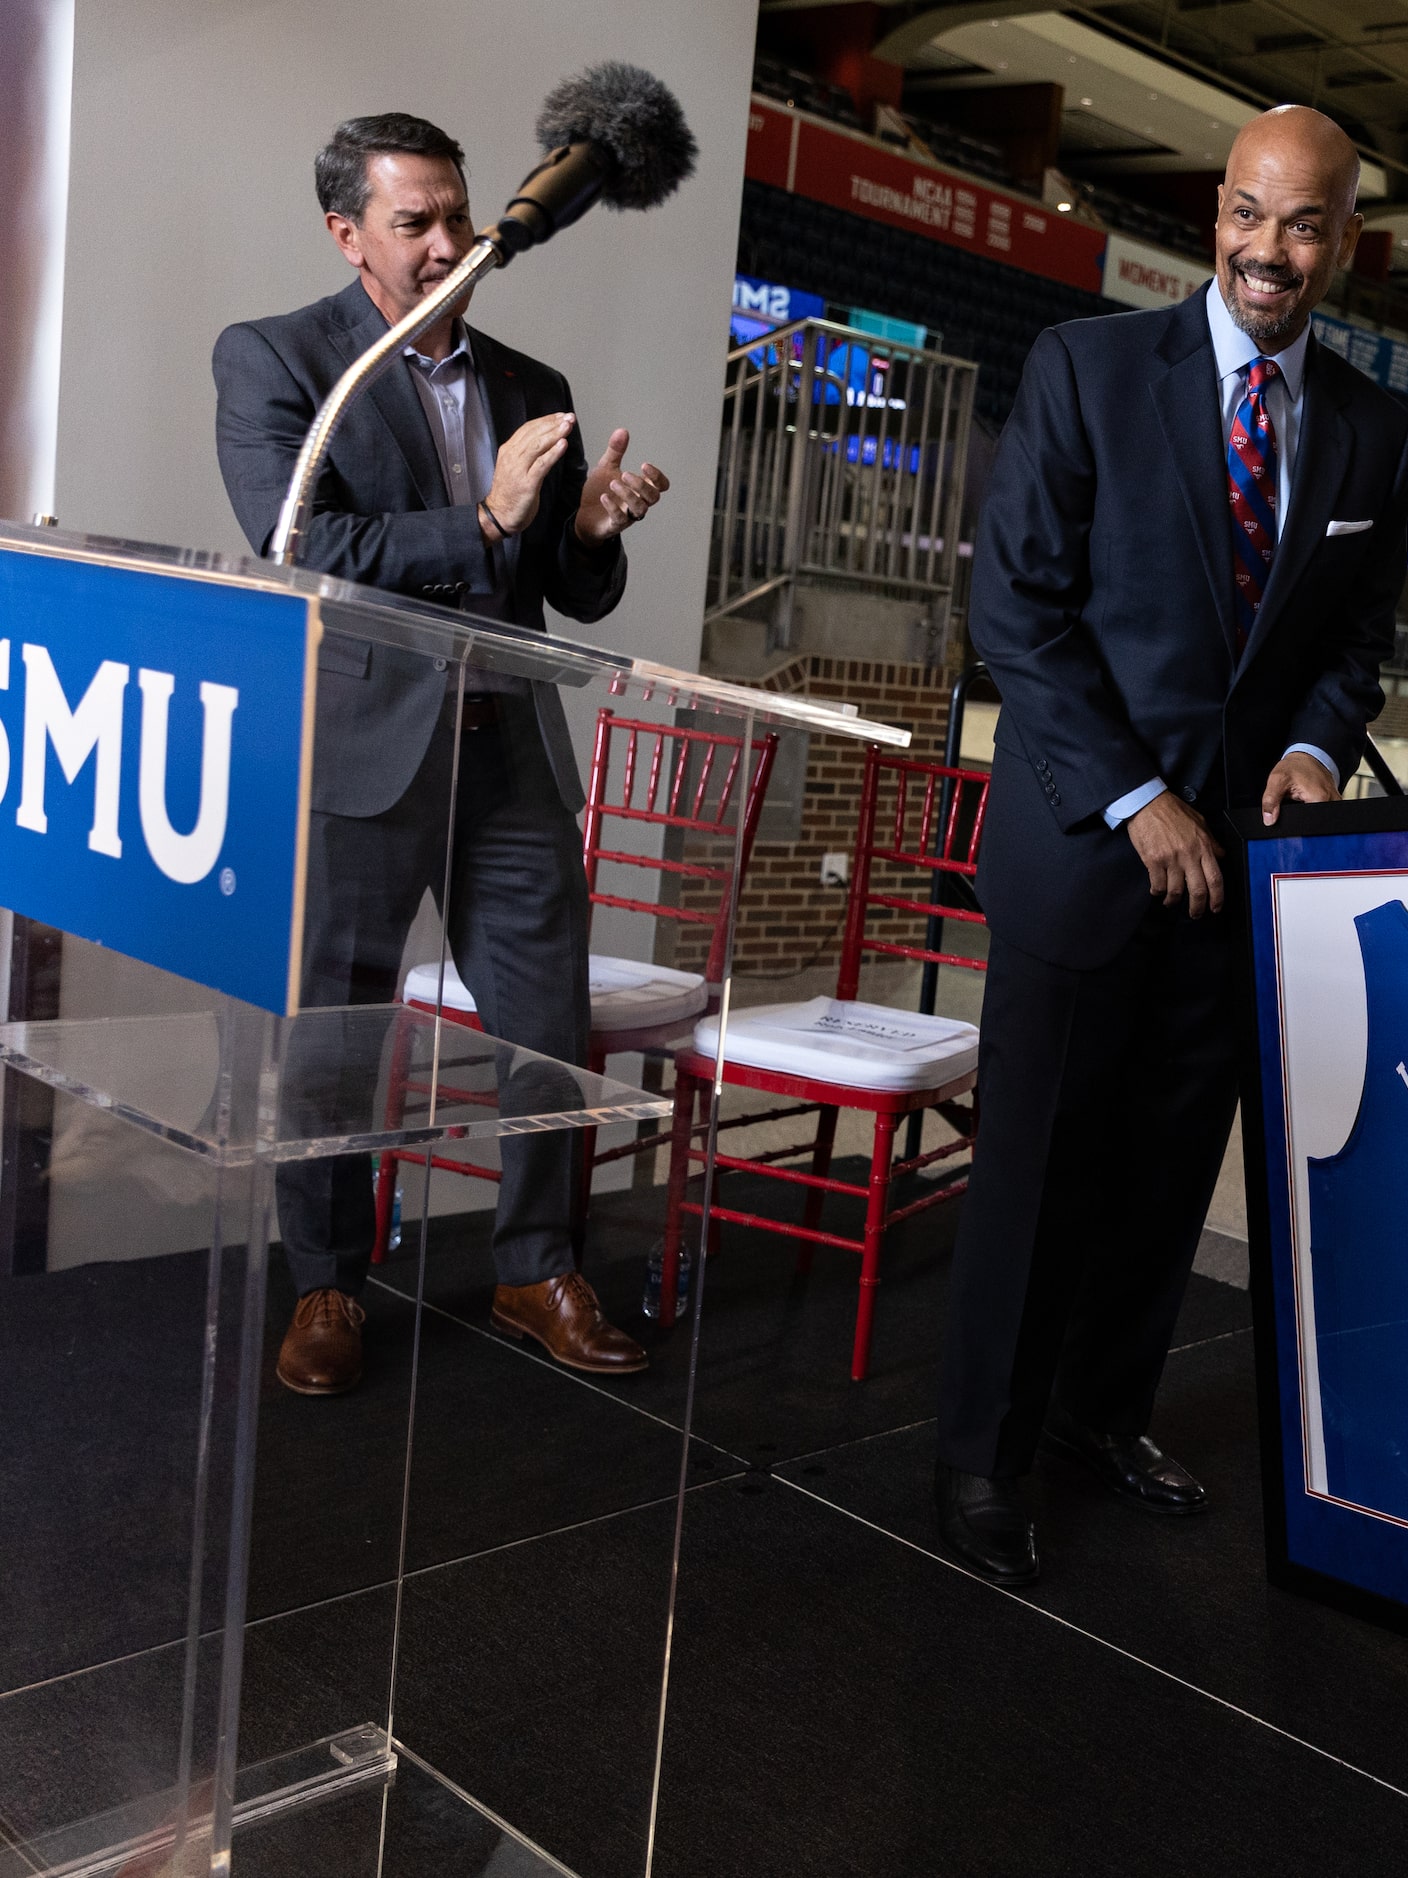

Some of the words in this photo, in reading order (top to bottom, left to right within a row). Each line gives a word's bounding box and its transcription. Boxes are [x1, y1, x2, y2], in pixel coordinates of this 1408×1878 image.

[851, 175, 950, 230] TOURNAMENT
[1118, 258, 1179, 299] WOMEN'S
[1233, 435, 1247, 445] SMU
[1252, 465, 1265, 474] SMU
[1230, 492, 1240, 500] MU
[1268, 495, 1276, 503] SM
[1244, 520, 1258, 529] SMU
[1236, 573, 1250, 582] SMU
[0, 638, 238, 884] MU
